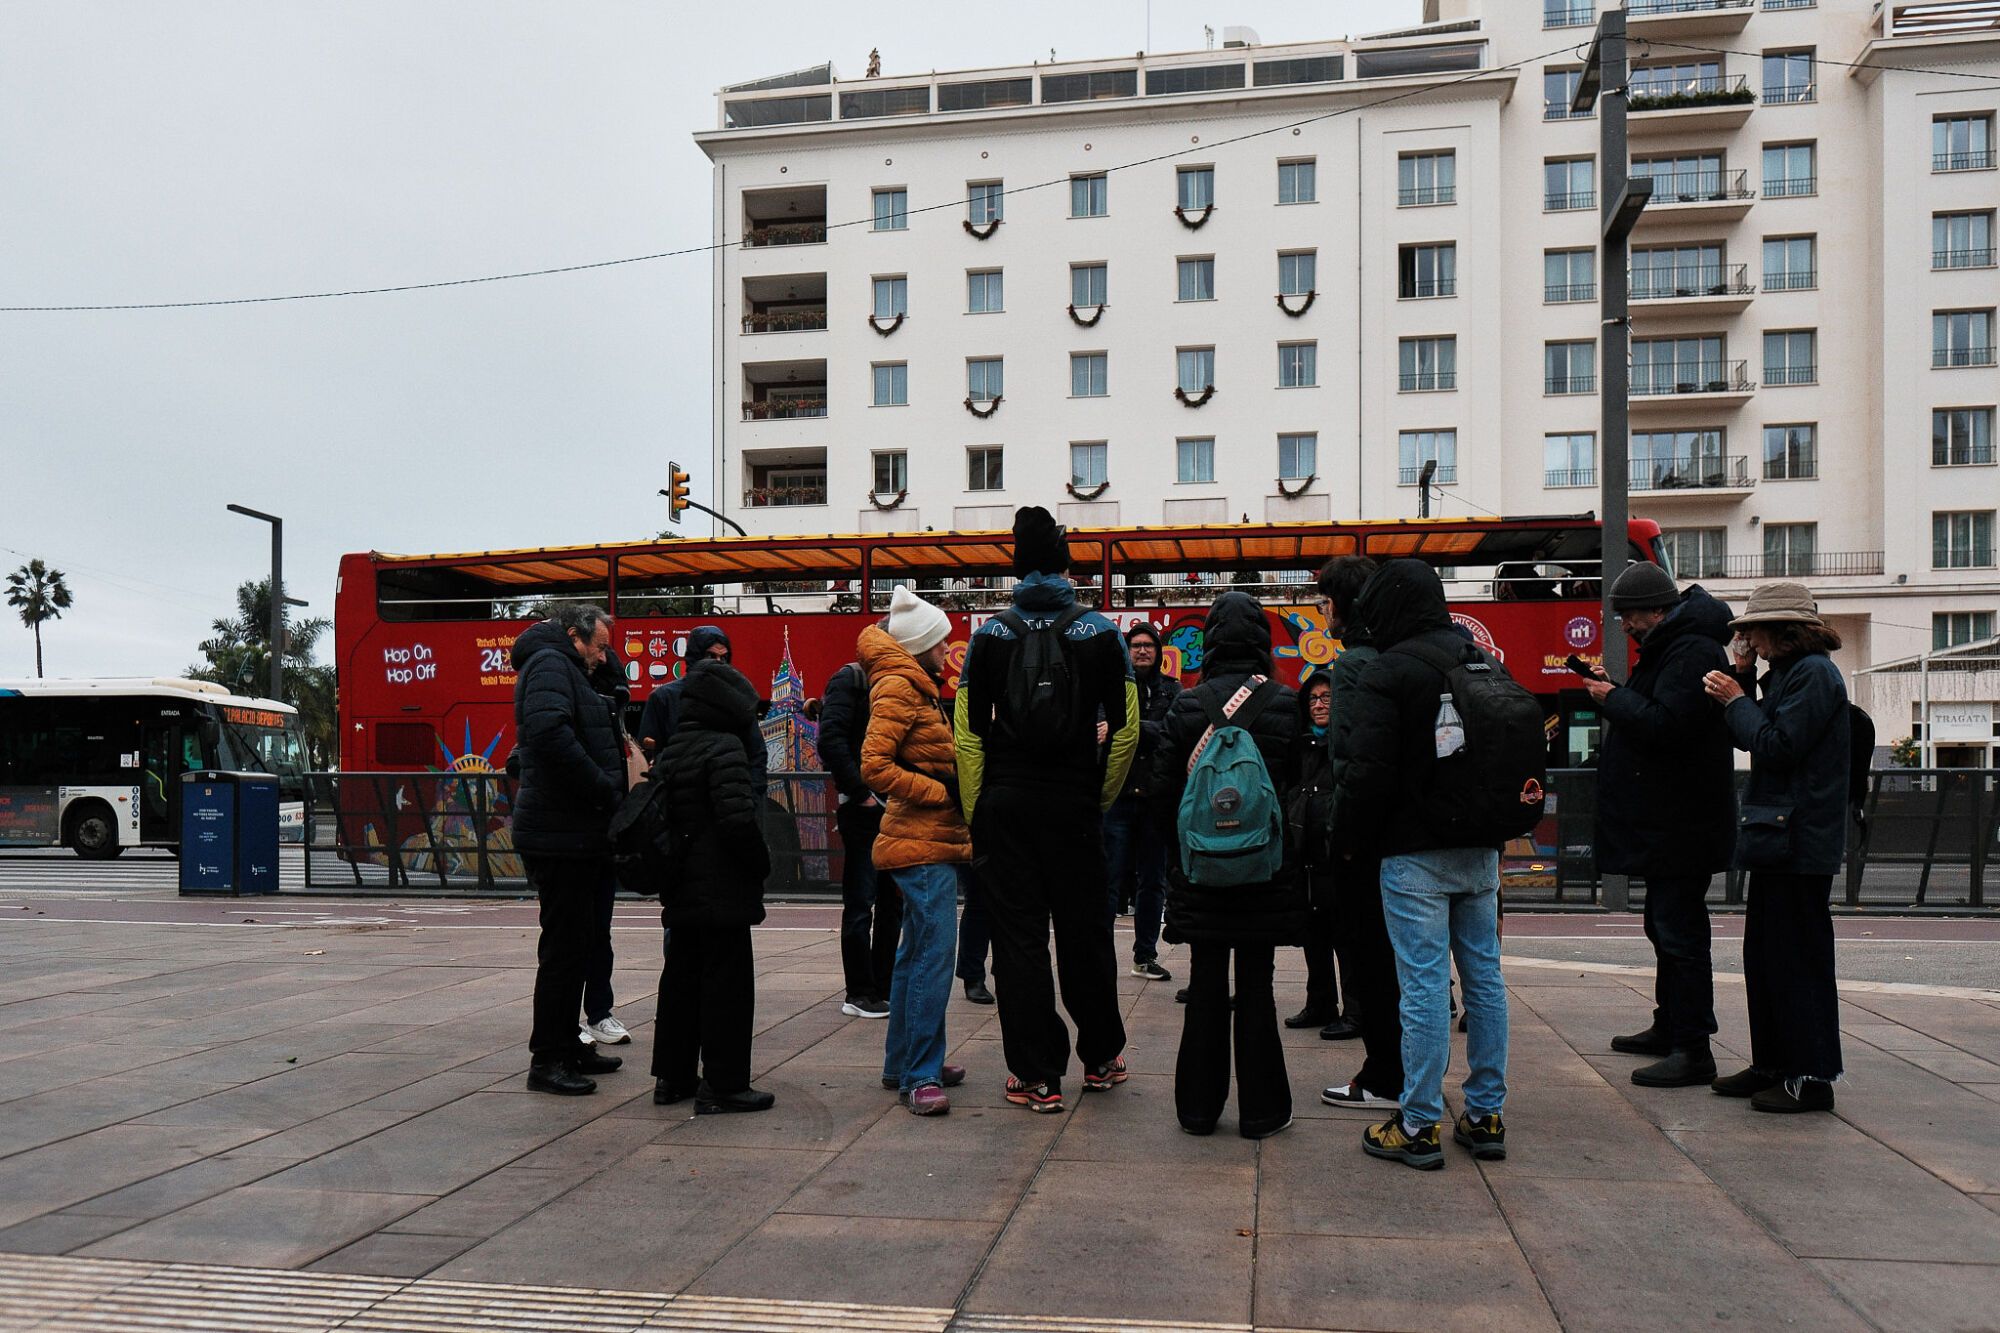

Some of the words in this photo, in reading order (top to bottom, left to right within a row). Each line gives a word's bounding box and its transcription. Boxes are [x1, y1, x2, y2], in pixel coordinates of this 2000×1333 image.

[384, 649, 410, 664] Hop
[413, 644, 432, 660] On
[480, 649, 502, 672] 24
[387, 669, 413, 684] Hop
[416, 663, 437, 680] Off
[230, 708, 256, 725] PALACIO
[256, 711, 284, 728] DEPORTES
[1935, 714, 1988, 723] TRAGATA
